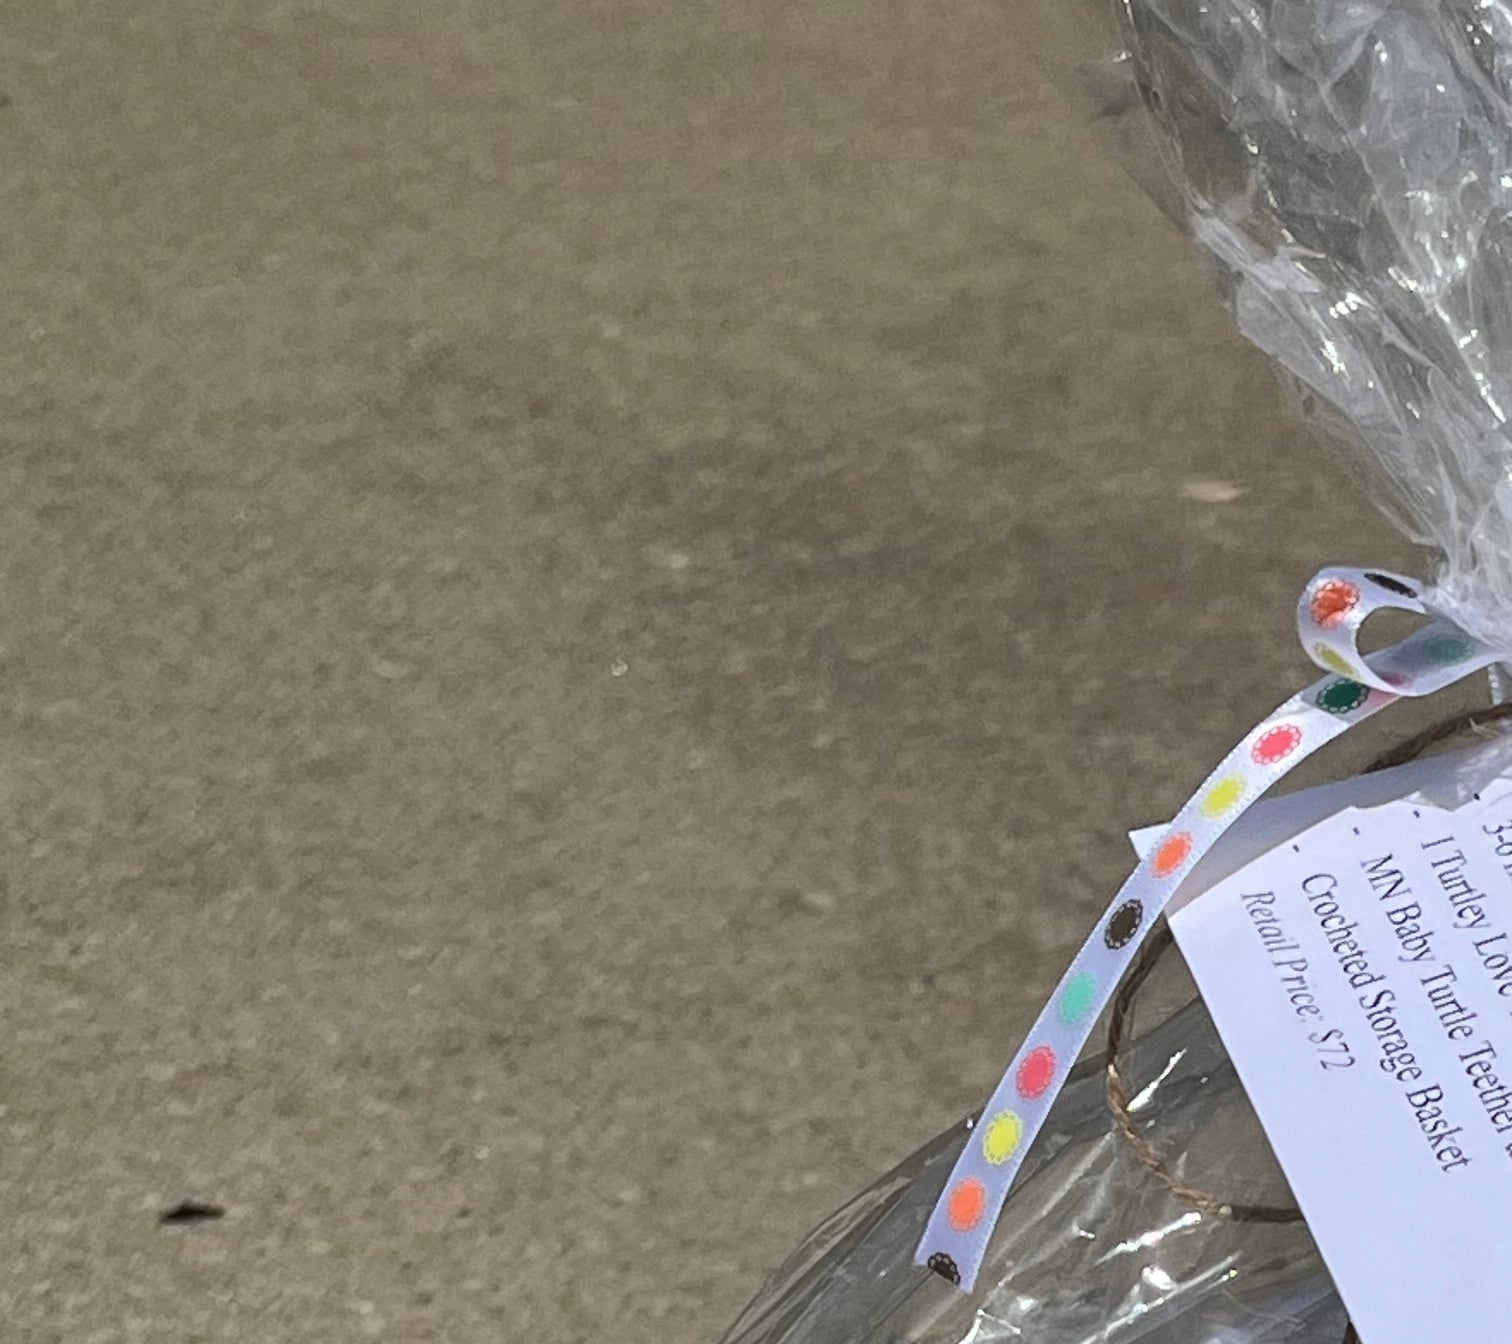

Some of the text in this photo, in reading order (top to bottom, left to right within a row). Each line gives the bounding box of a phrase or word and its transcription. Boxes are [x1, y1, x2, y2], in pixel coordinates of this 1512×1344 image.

[1358, 851, 1413, 902] MN
[1429, 847, 1492, 929] Turtley
[1383, 898, 1437, 963] Baby
[1241, 891, 1300, 954] Retail
[1306, 1027, 1357, 1070] $72
[1417, 962, 1479, 1041] Turtle
[1300, 871, 1473, 1174] Crocheted Storage Basket
